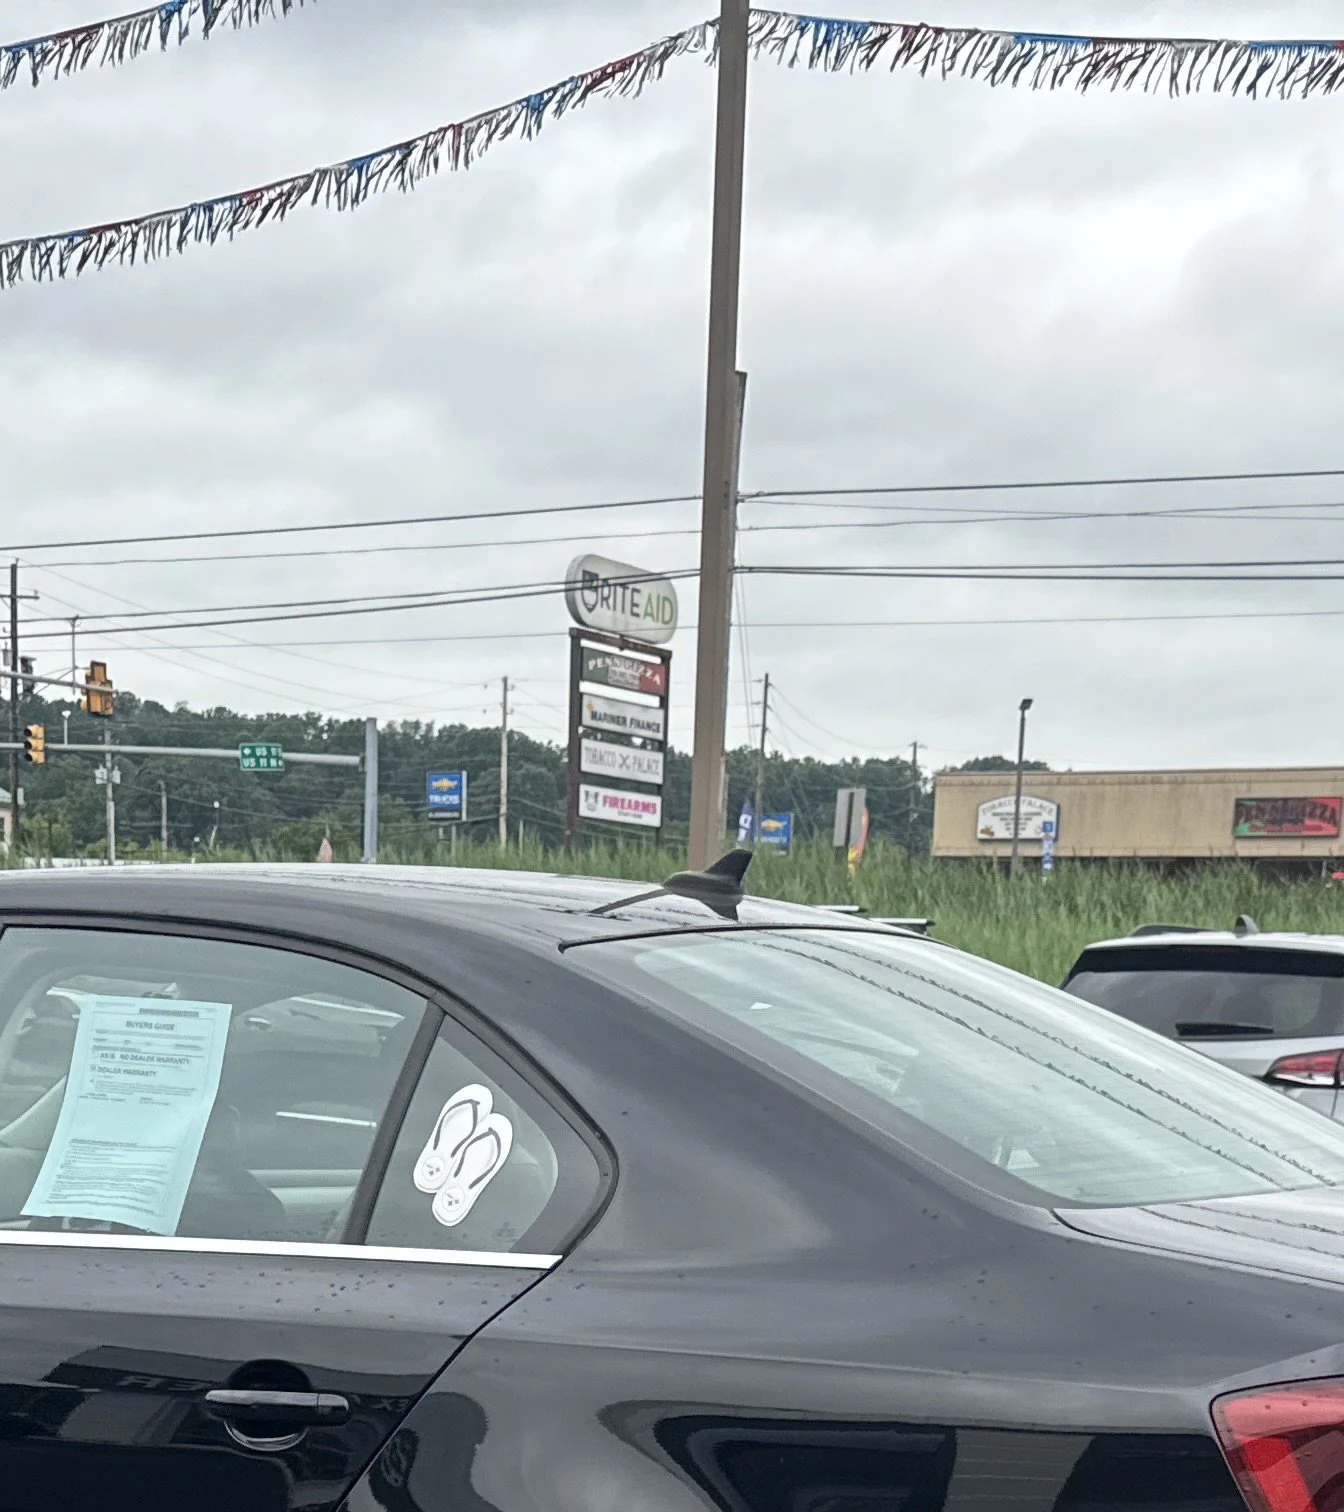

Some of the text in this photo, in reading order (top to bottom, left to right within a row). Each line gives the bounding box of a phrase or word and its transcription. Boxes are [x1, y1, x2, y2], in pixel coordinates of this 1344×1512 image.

[599, 578, 674, 626] RITE AID
[588, 655, 621, 671] PENN
[623, 659, 661, 686] PIZZA
[591, 710, 660, 733] MARINER FINANCE
[584, 746, 660, 776] TOBACCO PALACE
[602, 794, 657, 815] FIREARMS
[125, 1020, 175, 1031] BUYERS GUIDE
